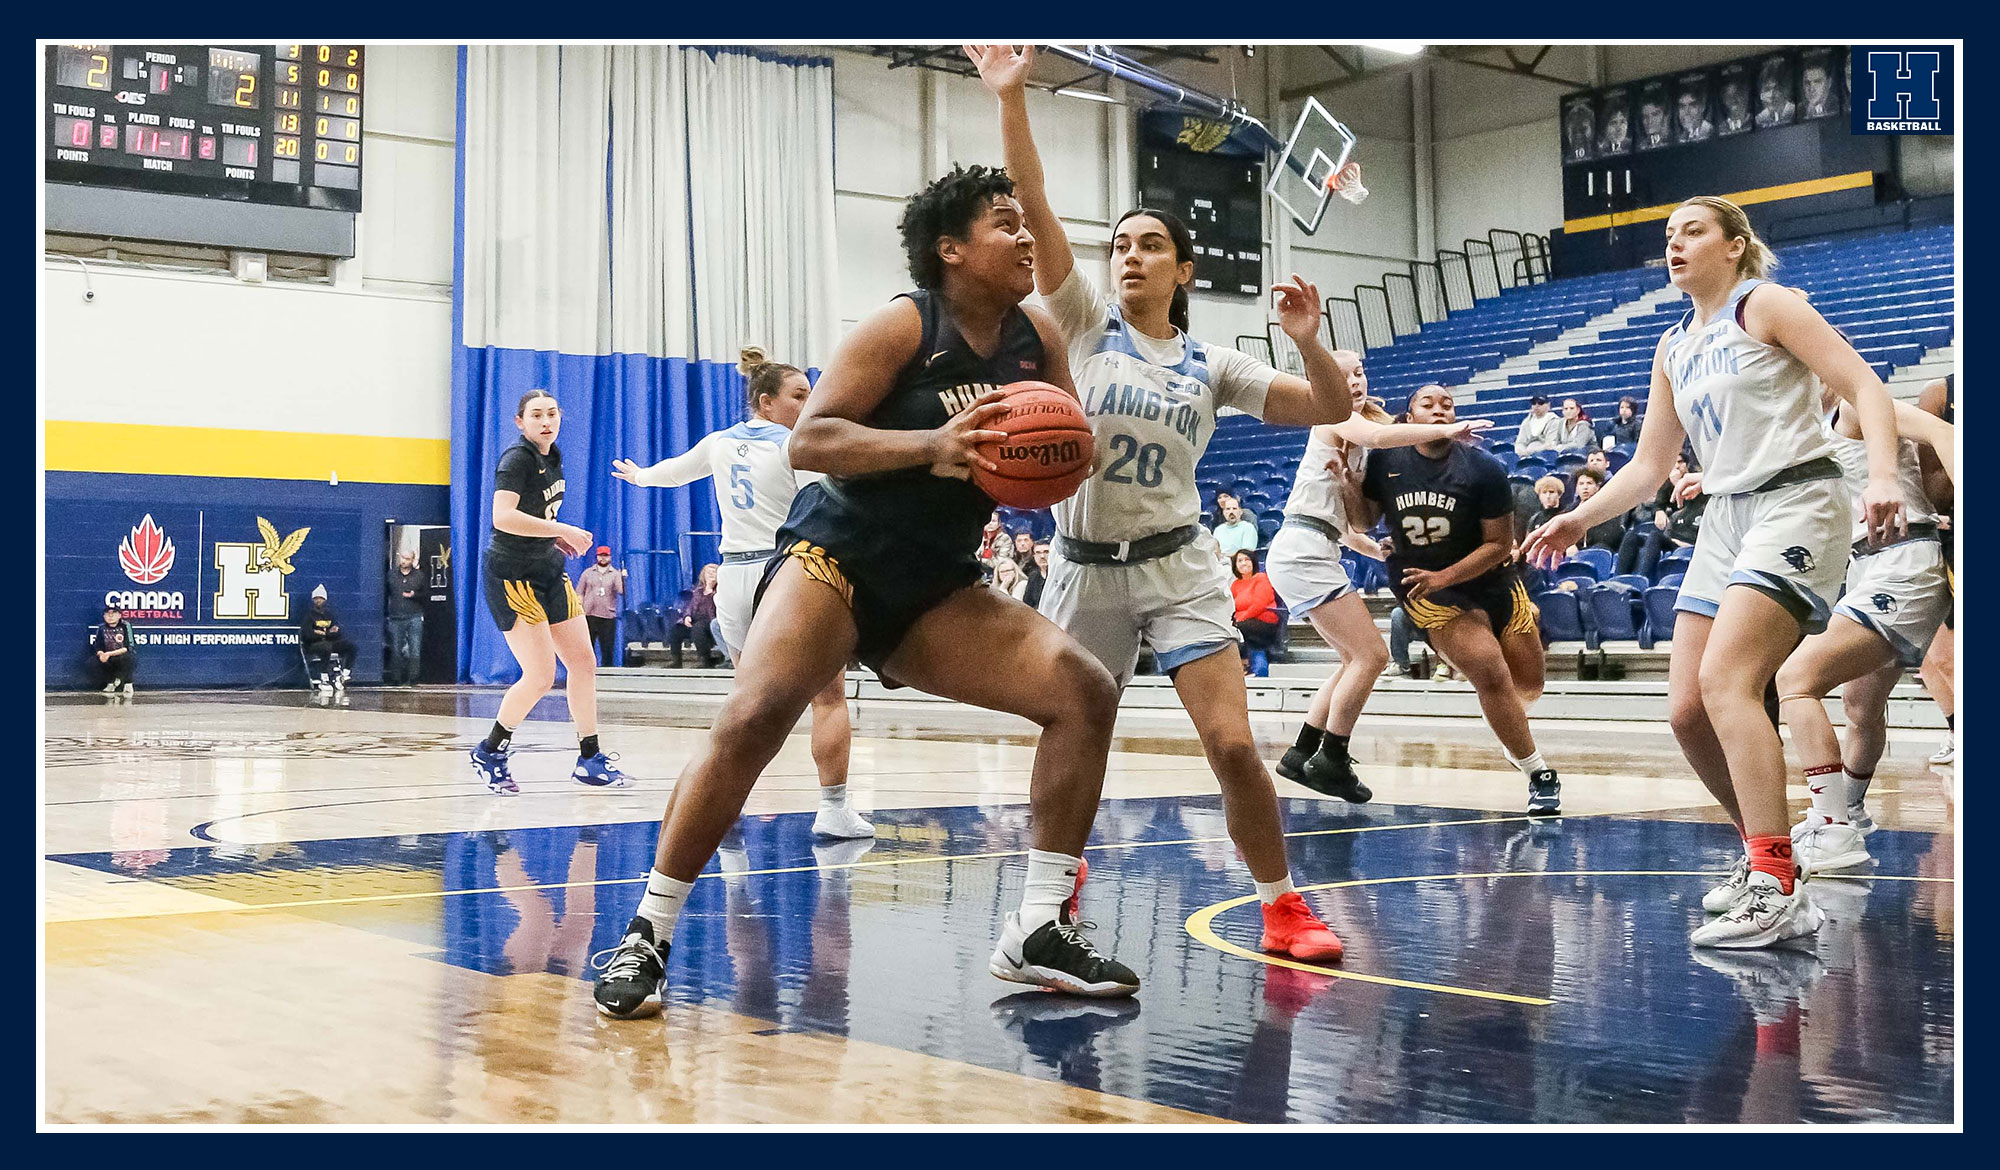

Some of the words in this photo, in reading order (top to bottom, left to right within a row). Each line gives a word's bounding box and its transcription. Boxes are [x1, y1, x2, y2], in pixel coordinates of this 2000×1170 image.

[146, 52, 176, 64] PERIOD
[86, 55, 108, 88] 2
[288, 65, 299, 83] 5
[318, 69, 330, 87] 0
[346, 73, 358, 91] 0
[235, 74, 255, 106] 2
[68, 105, 95, 118] FOULS
[345, 98, 357, 114] 0
[128, 112, 160, 125] PLAYER
[169, 117, 195, 129] FOULS
[235, 125, 261, 137] FOULS
[317, 118, 328, 136] 0
[345, 121, 357, 139] 0
[57, 149, 89, 162] POINTS
[275, 138, 297, 156] 20
[317, 143, 328, 160] 0
[345, 146, 356, 163] 0
[143, 159, 172, 171] MATCH
[225, 167, 255, 180] POINTS
[1085, 383, 1200, 447] LAMBTON
[1691, 392, 1722, 441] 11
[999, 441, 1080, 466] Wilson
[1103, 434, 1166, 488] 20
[731, 464, 755, 510] 5
[1396, 491, 1456, 512] HUMBER
[1402, 516, 1450, 546] 22
[213, 542, 289, 620] H
[105, 591, 184, 610] CANADA
[120, 610, 183, 619] SKETBALL
[150, 634, 163, 645] IN
[164, 634, 191, 645] HIGH
[193, 634, 273, 645] PERFORMANCE
[275, 634, 299, 645] TRAI
